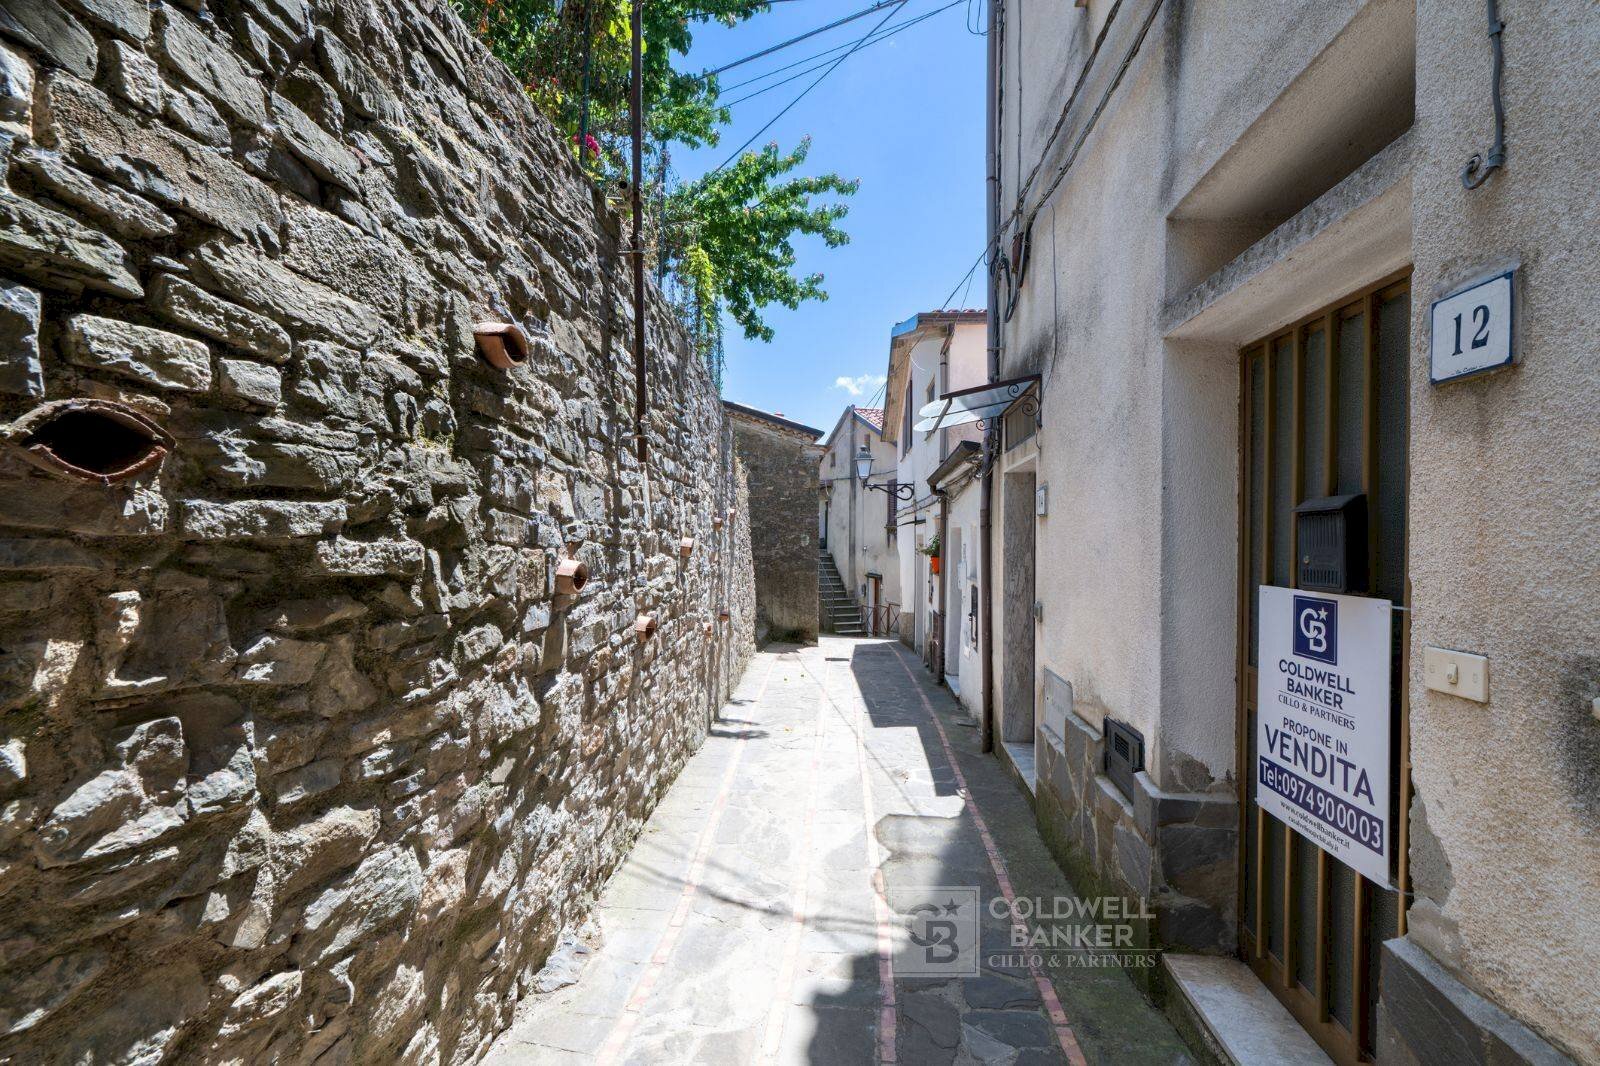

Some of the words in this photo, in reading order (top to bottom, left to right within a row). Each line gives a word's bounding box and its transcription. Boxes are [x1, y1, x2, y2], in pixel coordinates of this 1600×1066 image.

[1451, 304, 1491, 357] 12
[1278, 659, 1355, 695] COLDWELL
[1286, 677, 1344, 710] BANKER
[1278, 694, 1300, 710] CILLO
[1301, 702, 1308, 712] &
[1310, 705, 1355, 731] PARTNERS
[1282, 716, 1332, 749] PROPONE
[1335, 738, 1348, 756] IN
[1264, 723, 1375, 807] VENDITA
[1280, 801, 1350, 849] www.coldwellbanker.it
